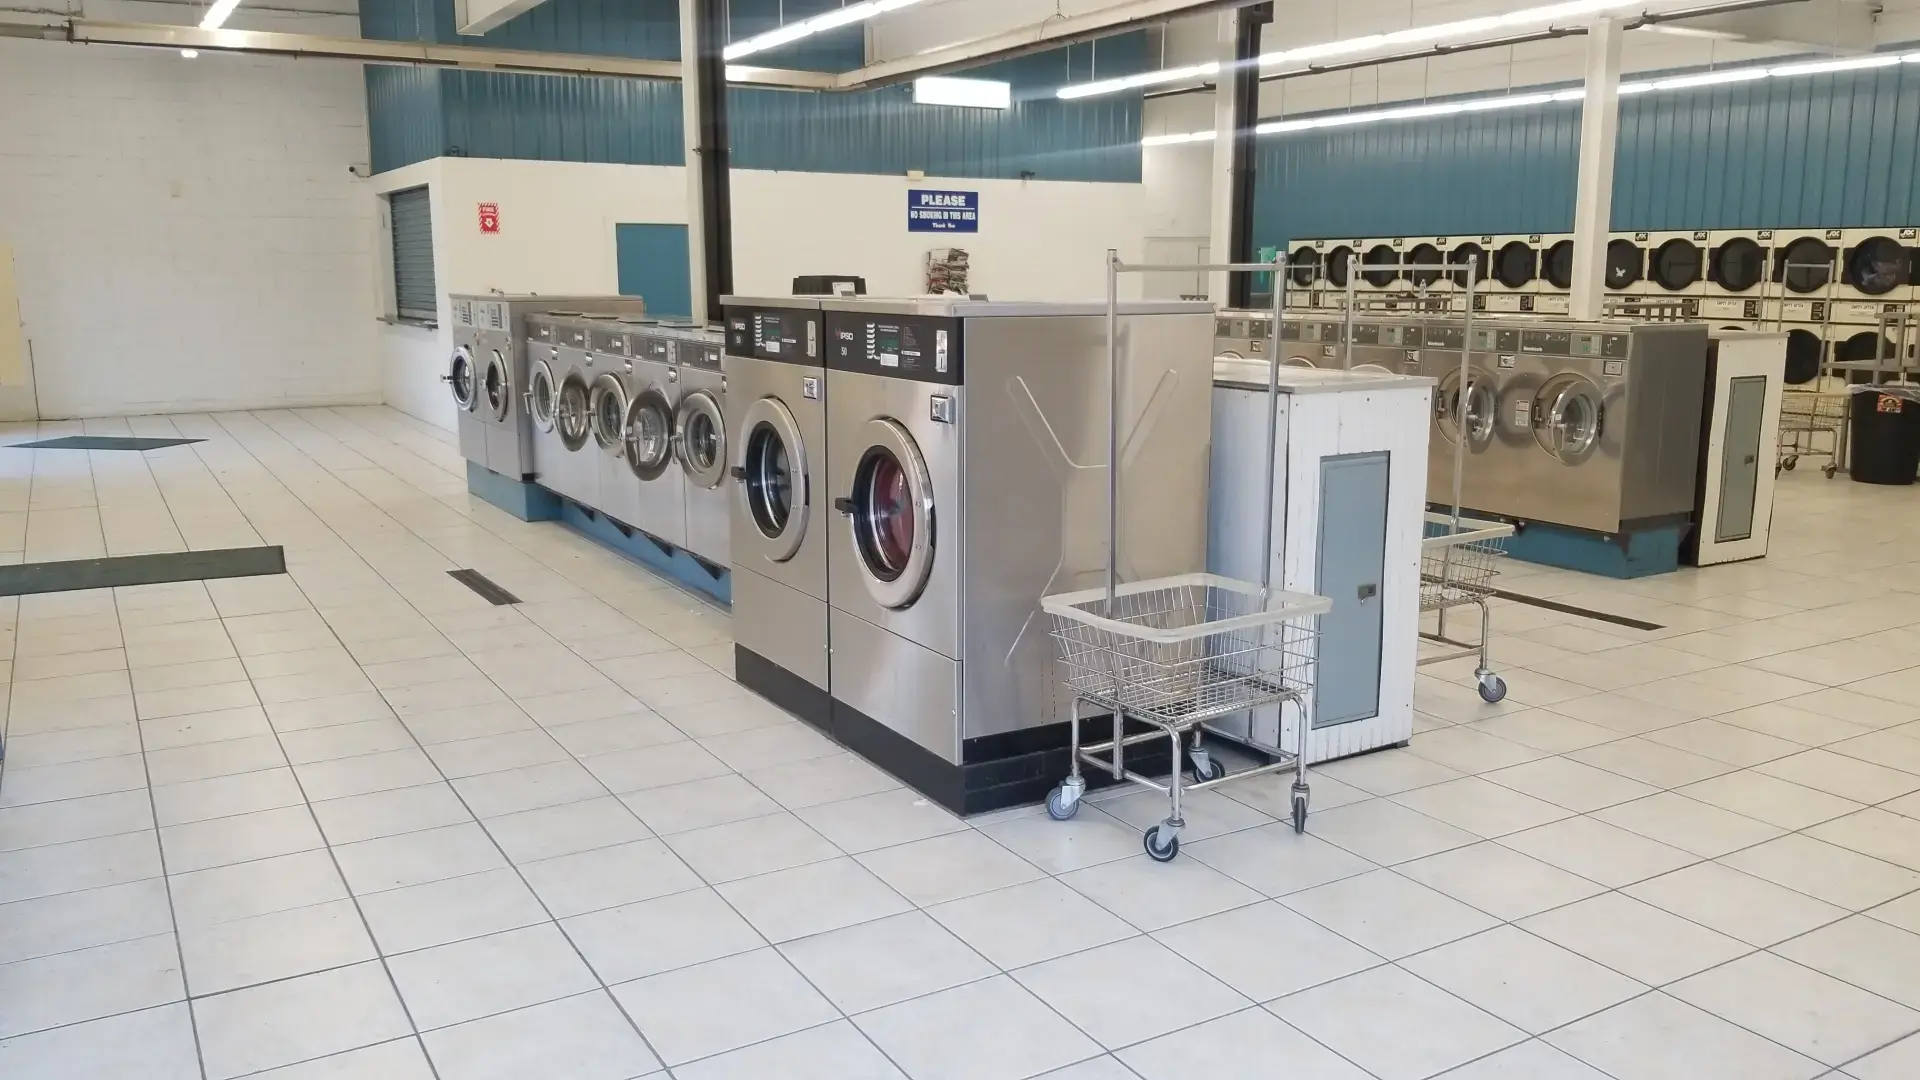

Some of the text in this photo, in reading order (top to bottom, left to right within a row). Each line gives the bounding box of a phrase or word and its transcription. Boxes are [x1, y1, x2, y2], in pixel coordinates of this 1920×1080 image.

[921, 194, 966, 206] PLEASE
[910, 211, 976, 220] NO SMOKING IN THIS AREA
[840, 331, 853, 340] IPSO
[841, 346, 847, 356] 50
